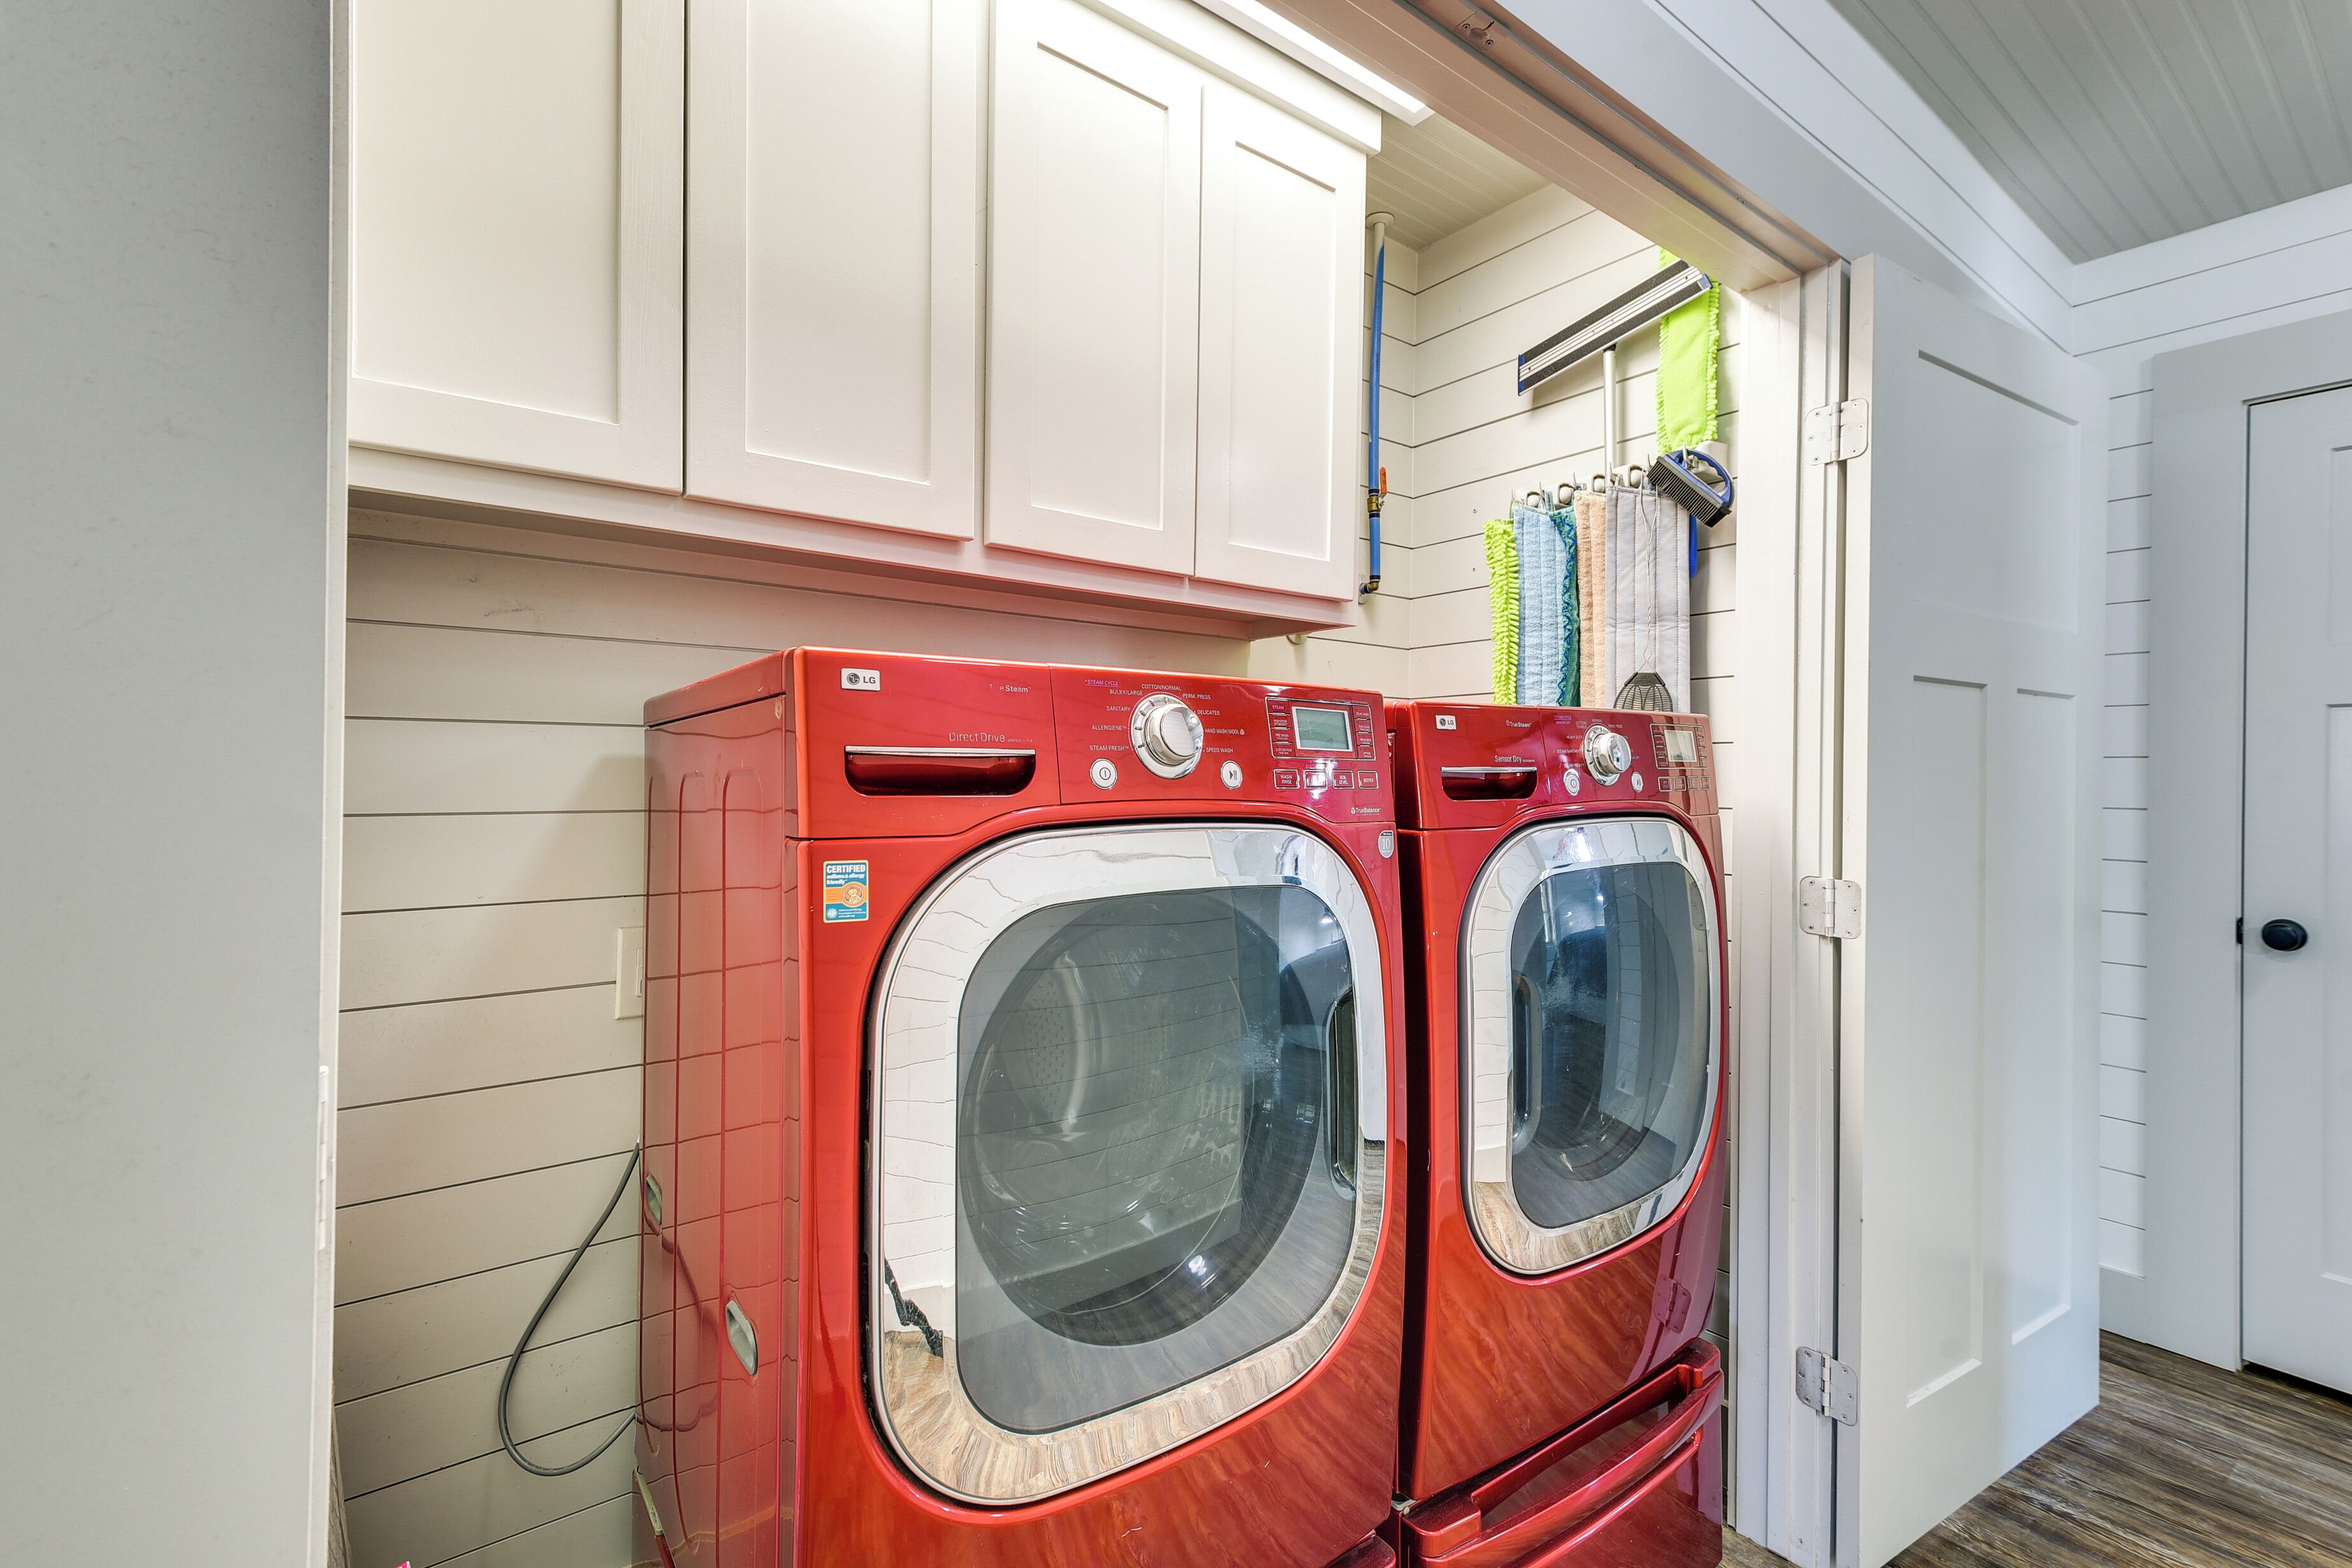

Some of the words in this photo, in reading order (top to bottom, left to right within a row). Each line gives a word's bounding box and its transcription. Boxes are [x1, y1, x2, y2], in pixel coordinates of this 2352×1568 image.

[863, 676, 876, 684] LG
[948, 732, 979, 742] Direct
[980, 732, 1005, 743] Drive
[1513, 755, 1522, 764] Dry
[1382, 838, 1391, 850] 10
[827, 864, 866, 873] CERTIFIED
